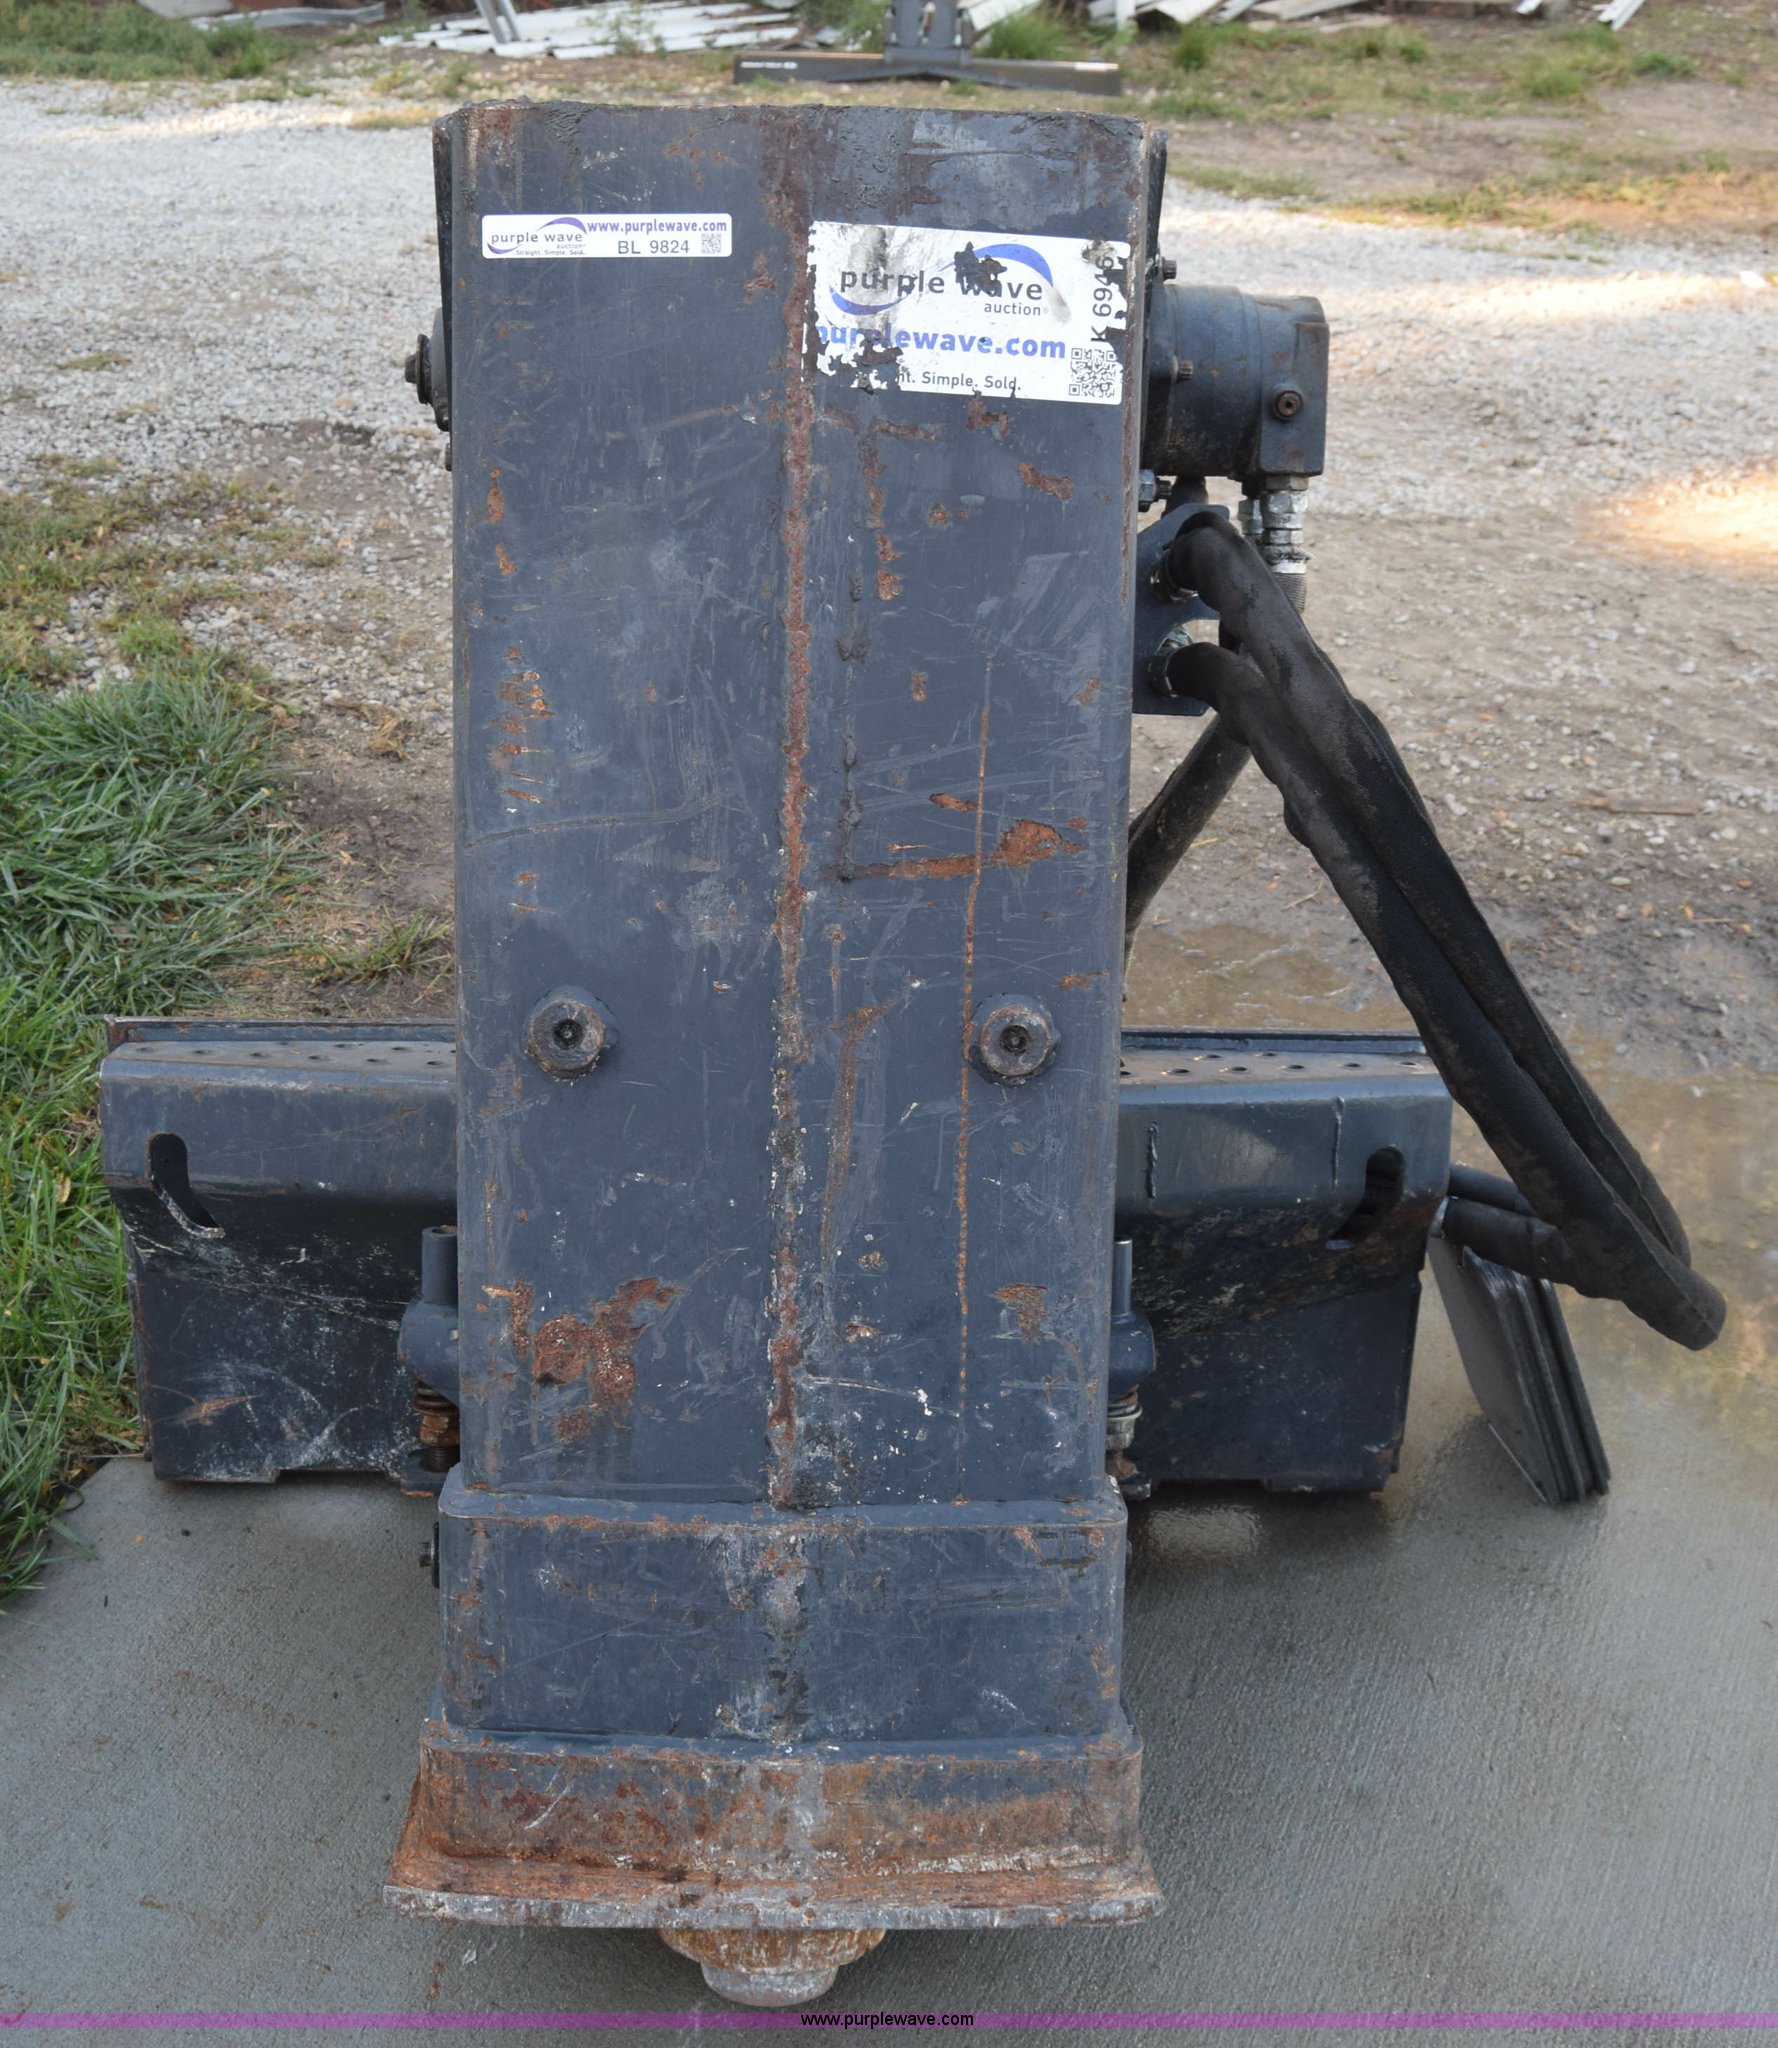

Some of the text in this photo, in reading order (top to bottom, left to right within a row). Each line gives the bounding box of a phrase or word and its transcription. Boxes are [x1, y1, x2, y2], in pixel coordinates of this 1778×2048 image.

[587, 218, 727, 235] www.purplewave.com
[491, 232, 583, 245] purple wave
[617, 239, 690, 255] BL 9824
[840, 270, 945, 297] purple
[1091, 256, 1114, 342] K 6946
[922, 371, 978, 390] Simple.
[984, 374, 1022, 392] Sold.
